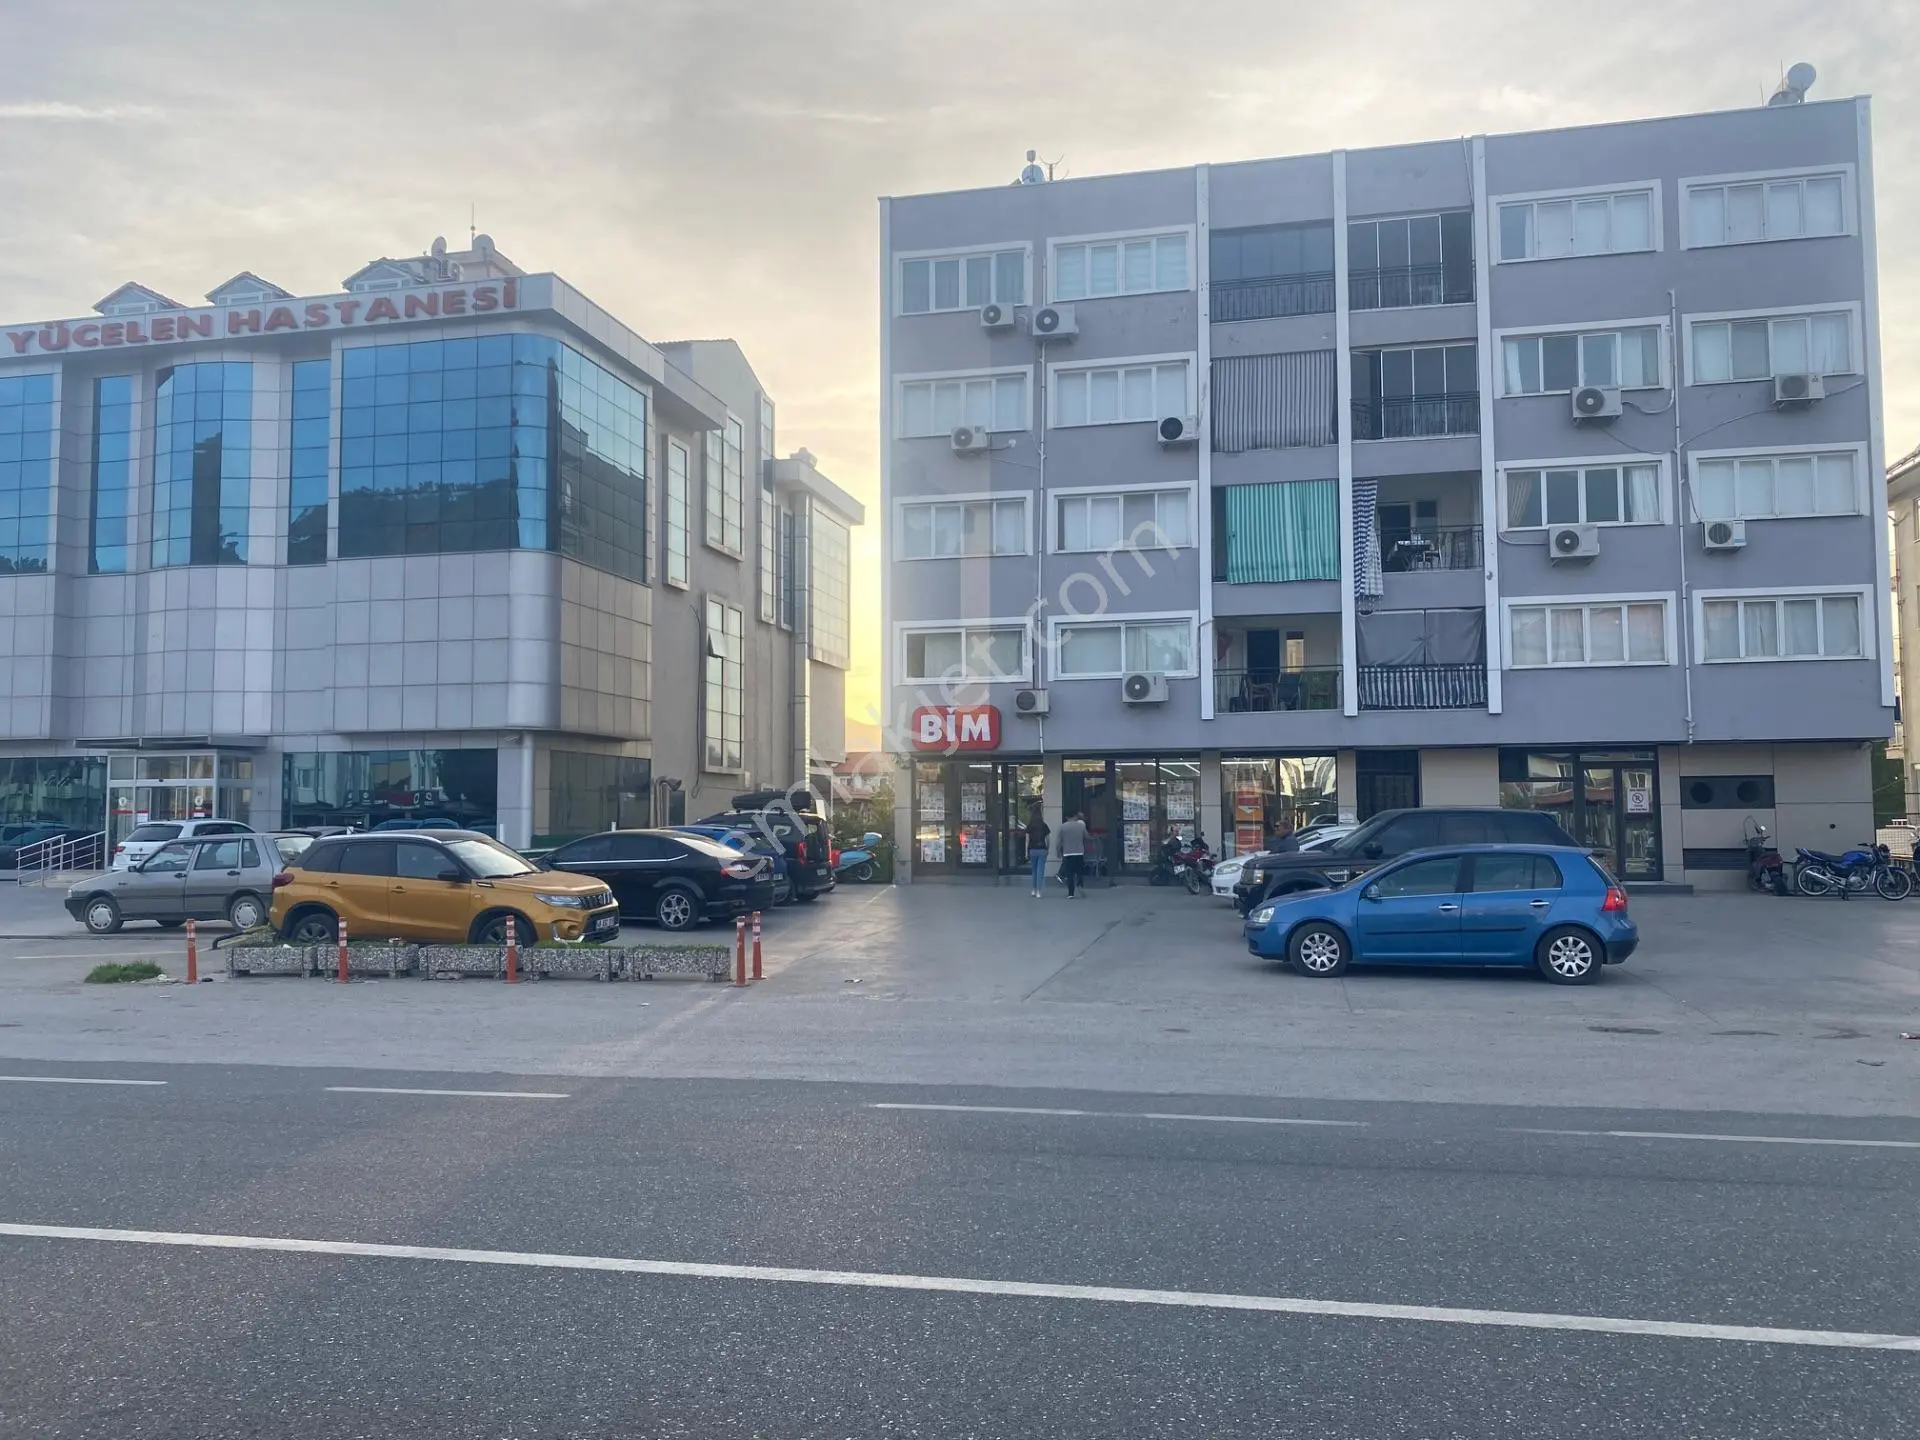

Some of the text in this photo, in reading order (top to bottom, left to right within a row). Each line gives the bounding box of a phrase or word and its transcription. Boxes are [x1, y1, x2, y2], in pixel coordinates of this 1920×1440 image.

[6, 277, 518, 354] YÜCELEN HASTANESİ
[920, 707, 991, 743] BİM
